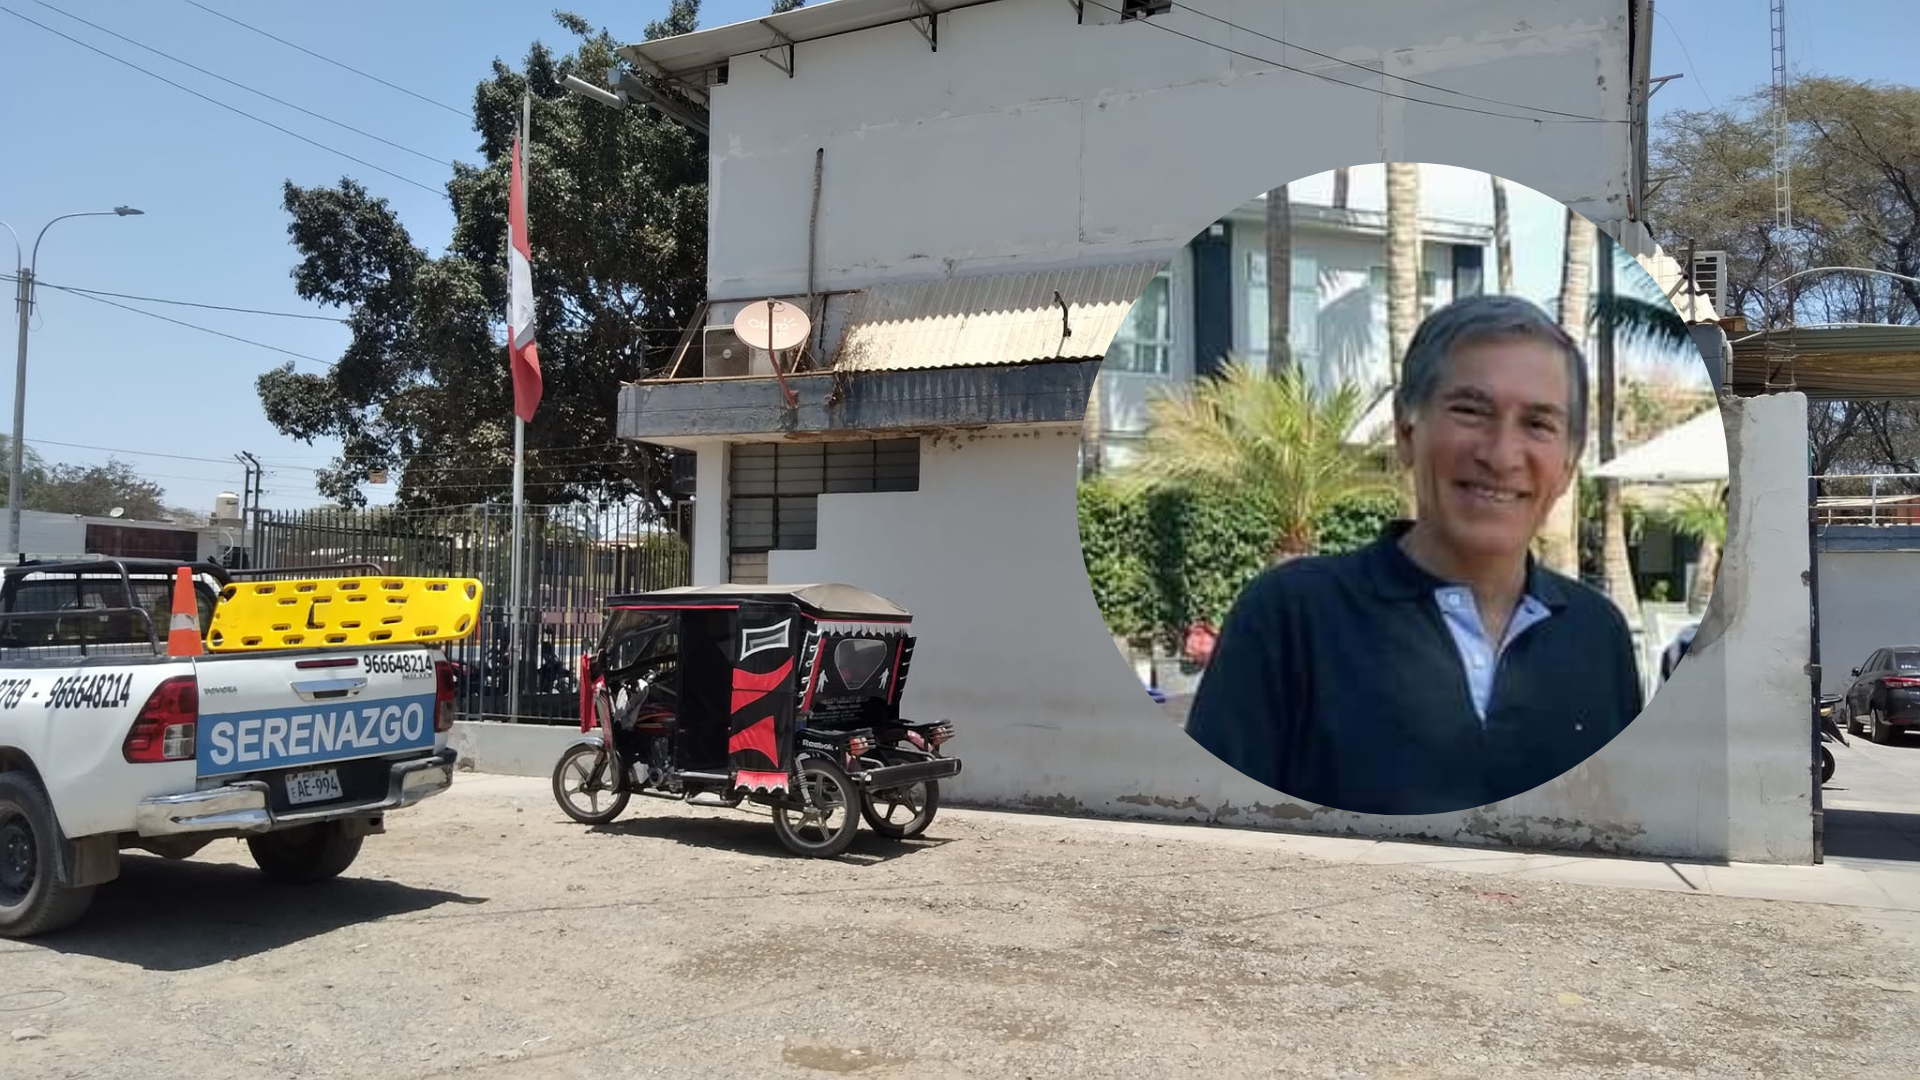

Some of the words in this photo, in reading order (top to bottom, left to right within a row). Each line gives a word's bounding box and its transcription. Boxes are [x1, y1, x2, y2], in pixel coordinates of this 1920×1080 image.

[363, 654, 433, 674] 966648214
[44, 672, 134, 709] 966648214
[209, 702, 424, 766] SERENAZGO
